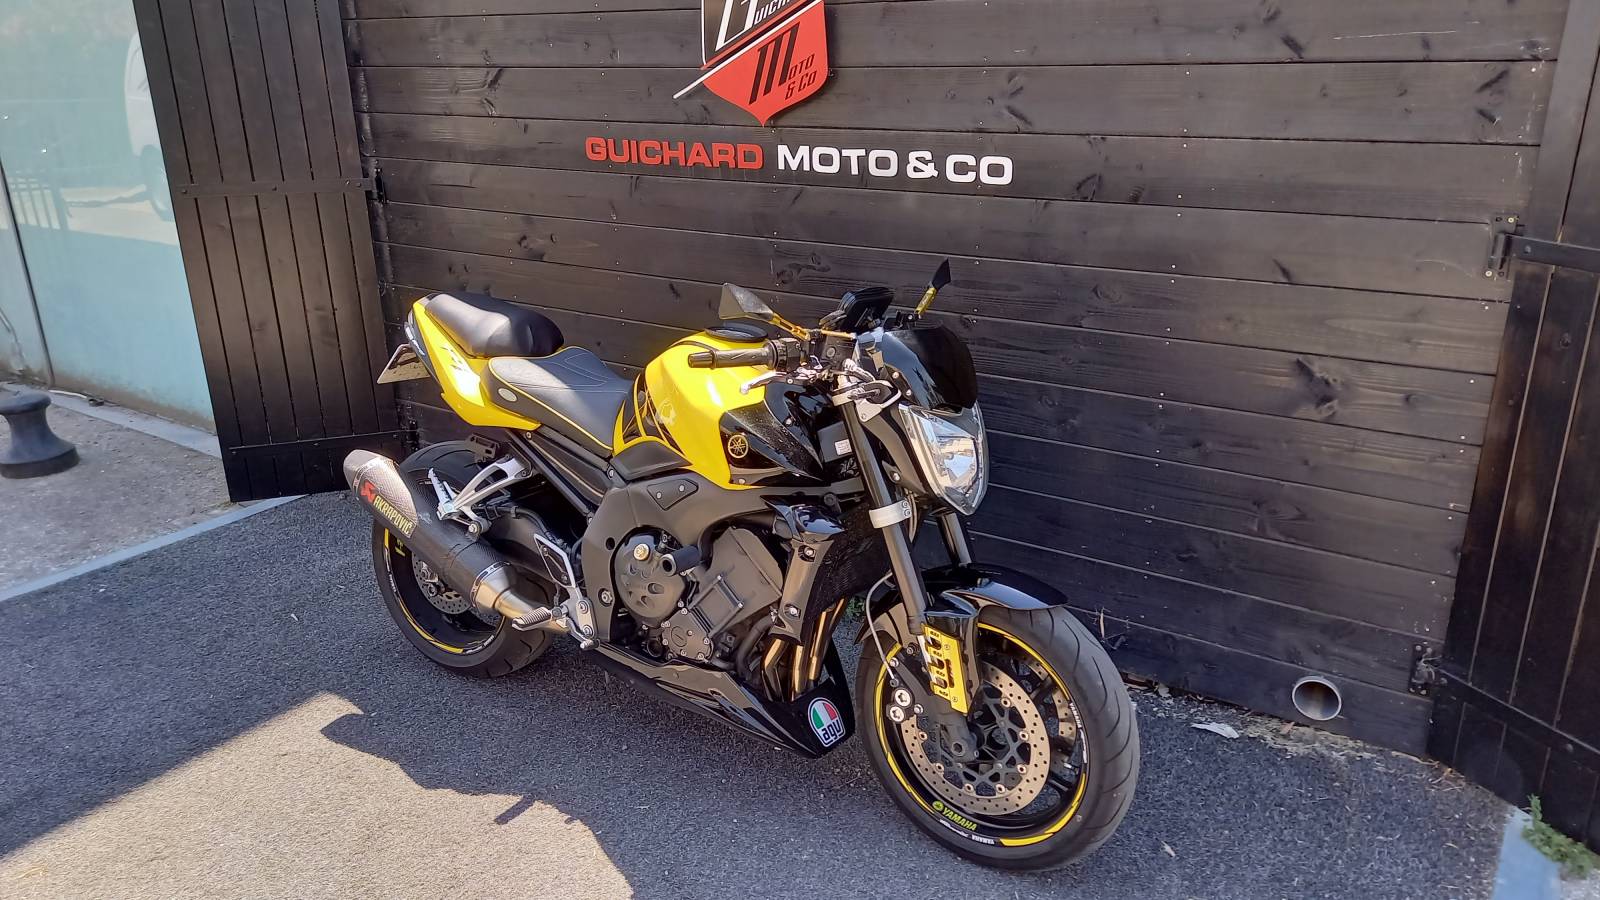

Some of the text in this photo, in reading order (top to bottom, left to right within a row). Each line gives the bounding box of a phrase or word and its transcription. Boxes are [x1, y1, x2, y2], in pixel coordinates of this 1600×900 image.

[785, 82, 796, 100] &
[585, 136, 1014, 186] GUICHARD MOTO & CO
[942, 807, 977, 831] YAMAHA
